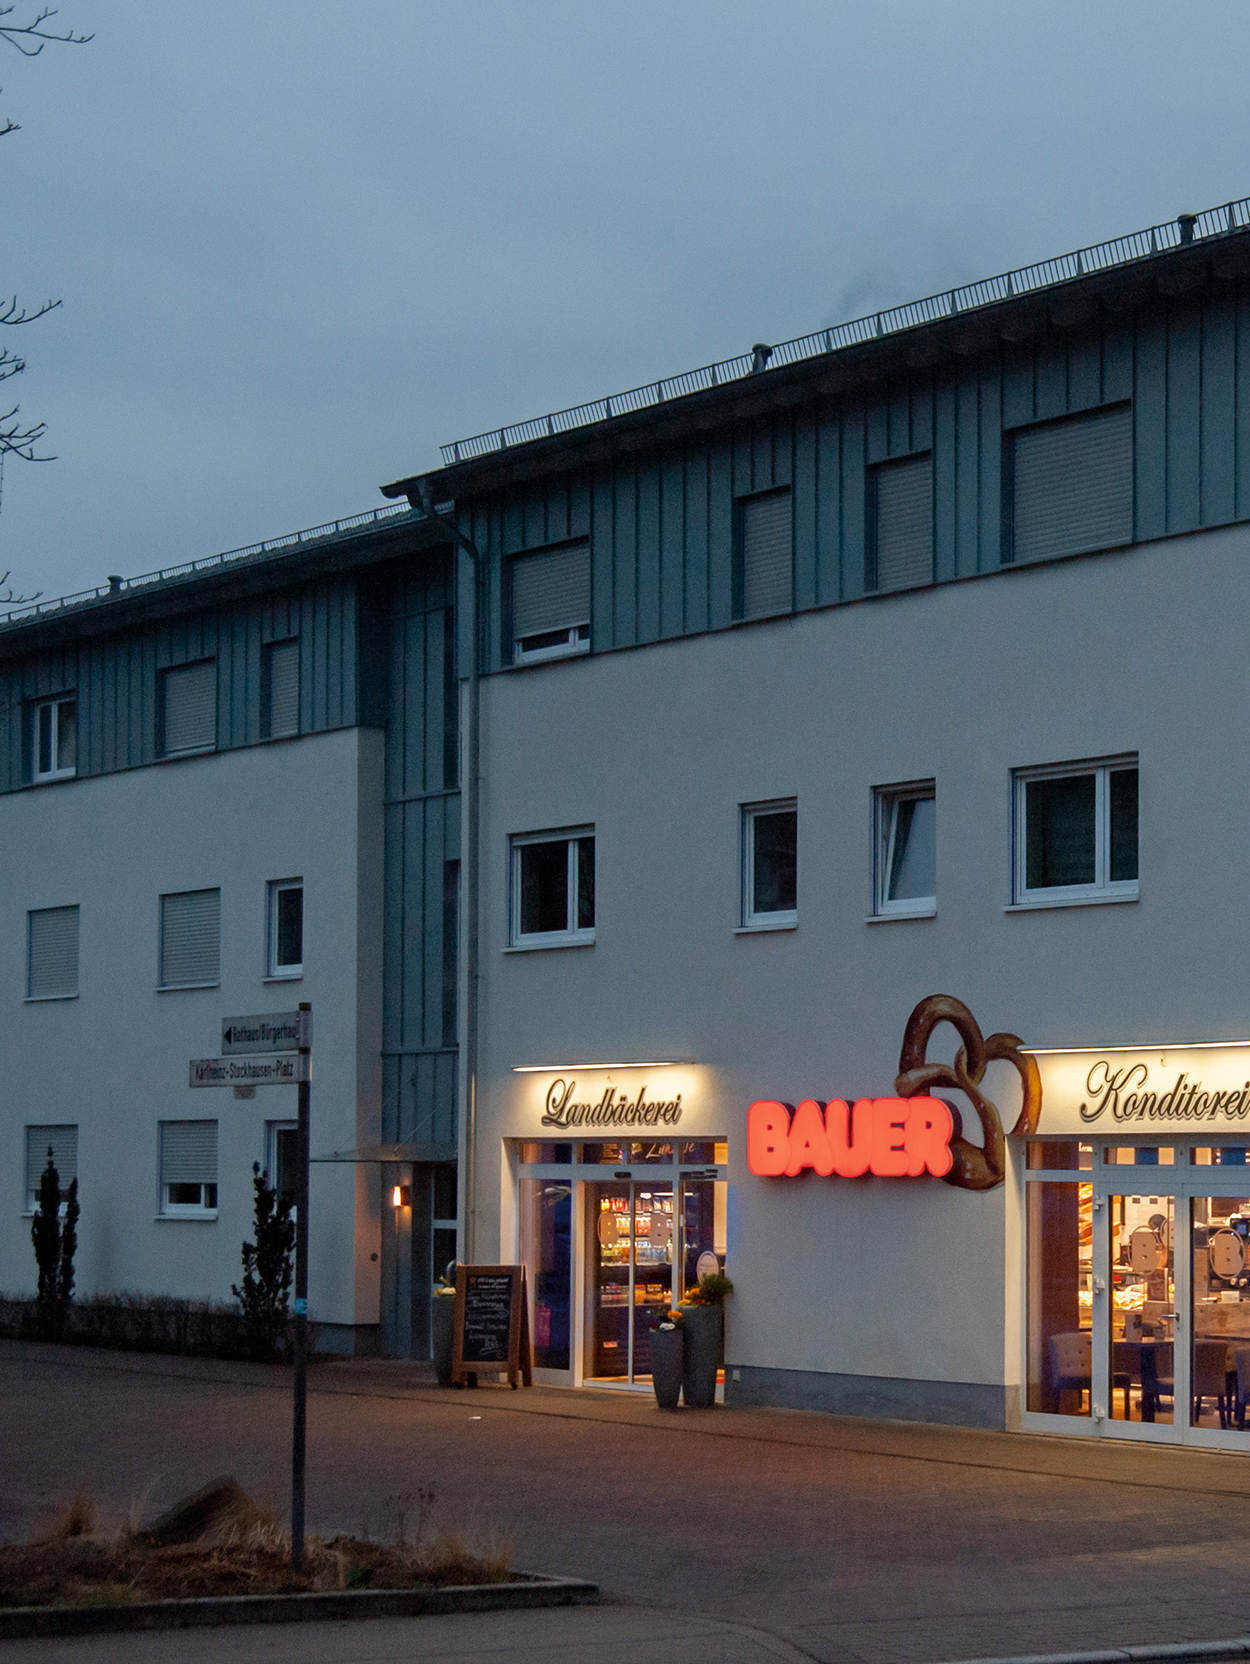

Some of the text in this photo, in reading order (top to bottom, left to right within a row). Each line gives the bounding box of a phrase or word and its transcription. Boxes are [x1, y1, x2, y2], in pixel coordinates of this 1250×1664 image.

[195, 1059, 294, 1081] Karlheinz-Stockhausen-Platz
[541, 1078, 683, 1129] Landbäckerei
[747, 1096, 955, 1177] BAUER
